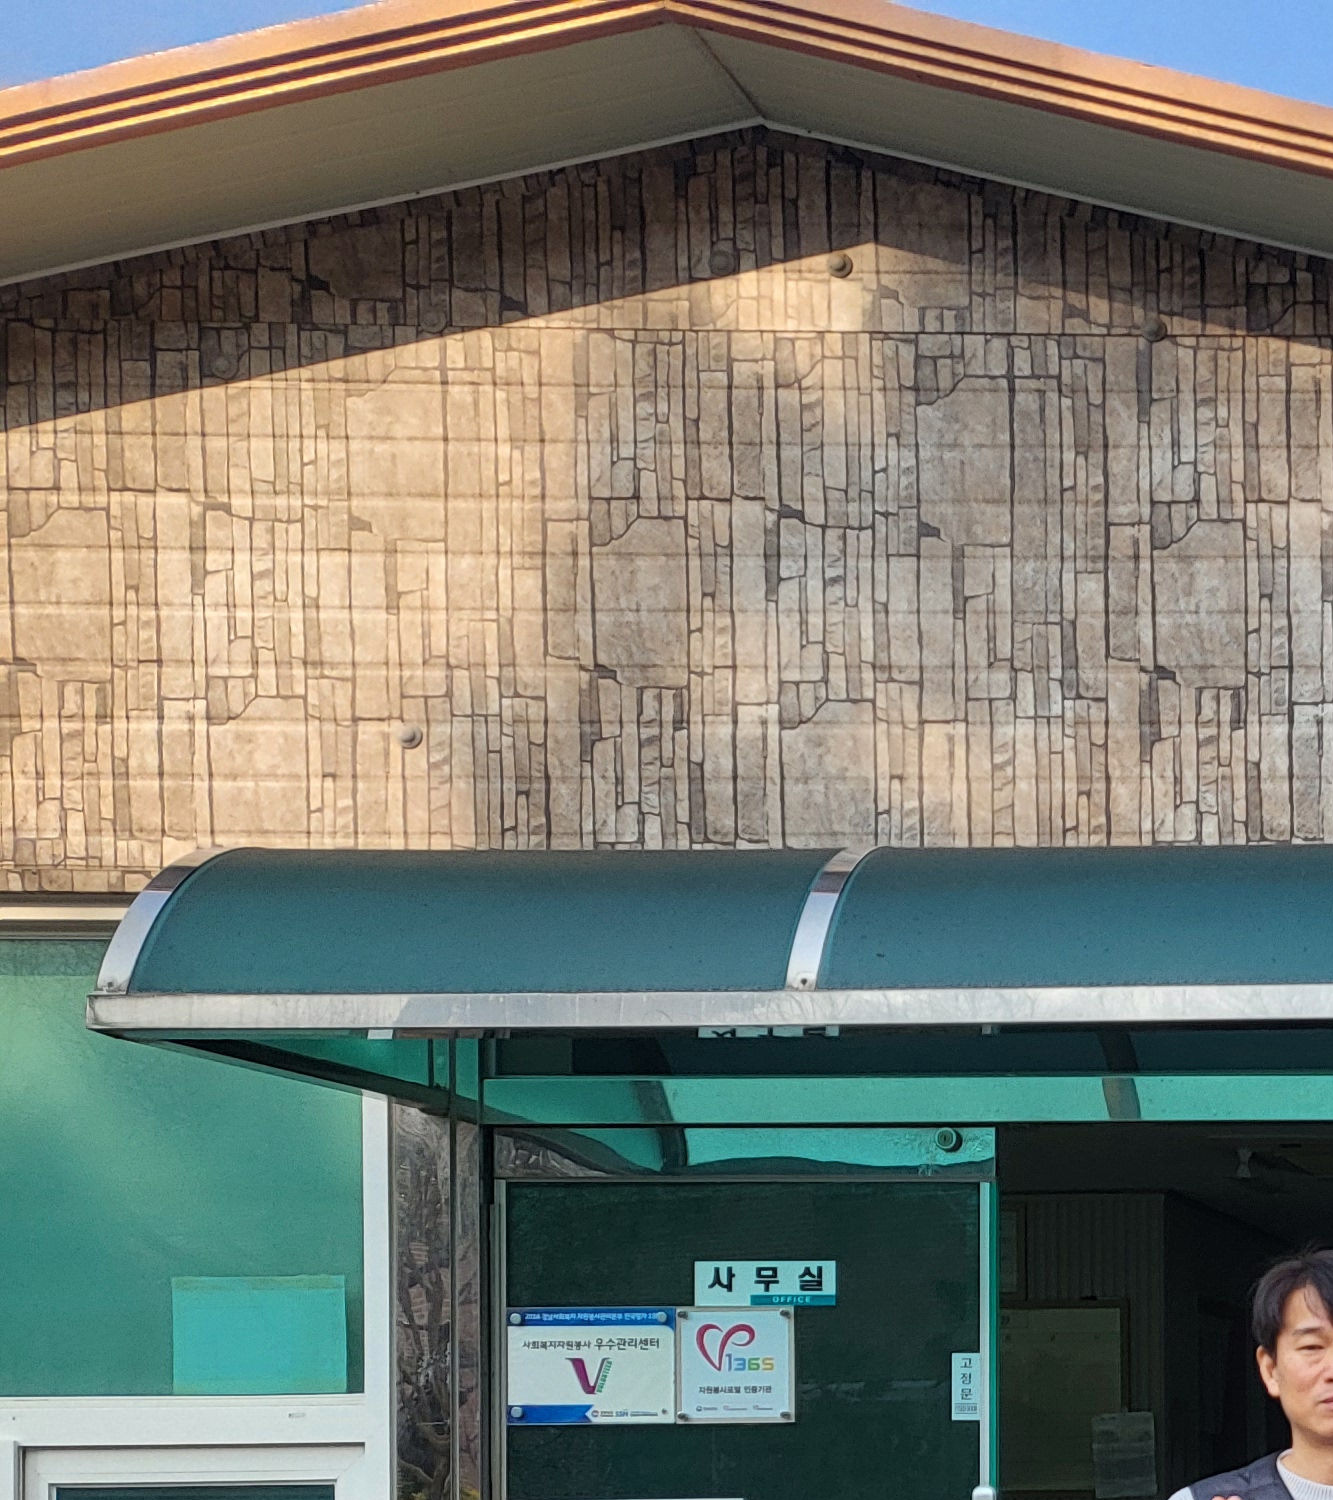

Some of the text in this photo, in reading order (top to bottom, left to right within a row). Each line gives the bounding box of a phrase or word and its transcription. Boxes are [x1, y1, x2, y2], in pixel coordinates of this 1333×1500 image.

[708, 1266, 823, 1293] 사무실
[522, 1337, 660, 1351] 사회복지자원봉사 우수관리센터
[725, 1353, 774, 1372] 1365
[960, 1357, 973, 1400] 고정문
[744, 1385, 772, 1394] 인증기관
